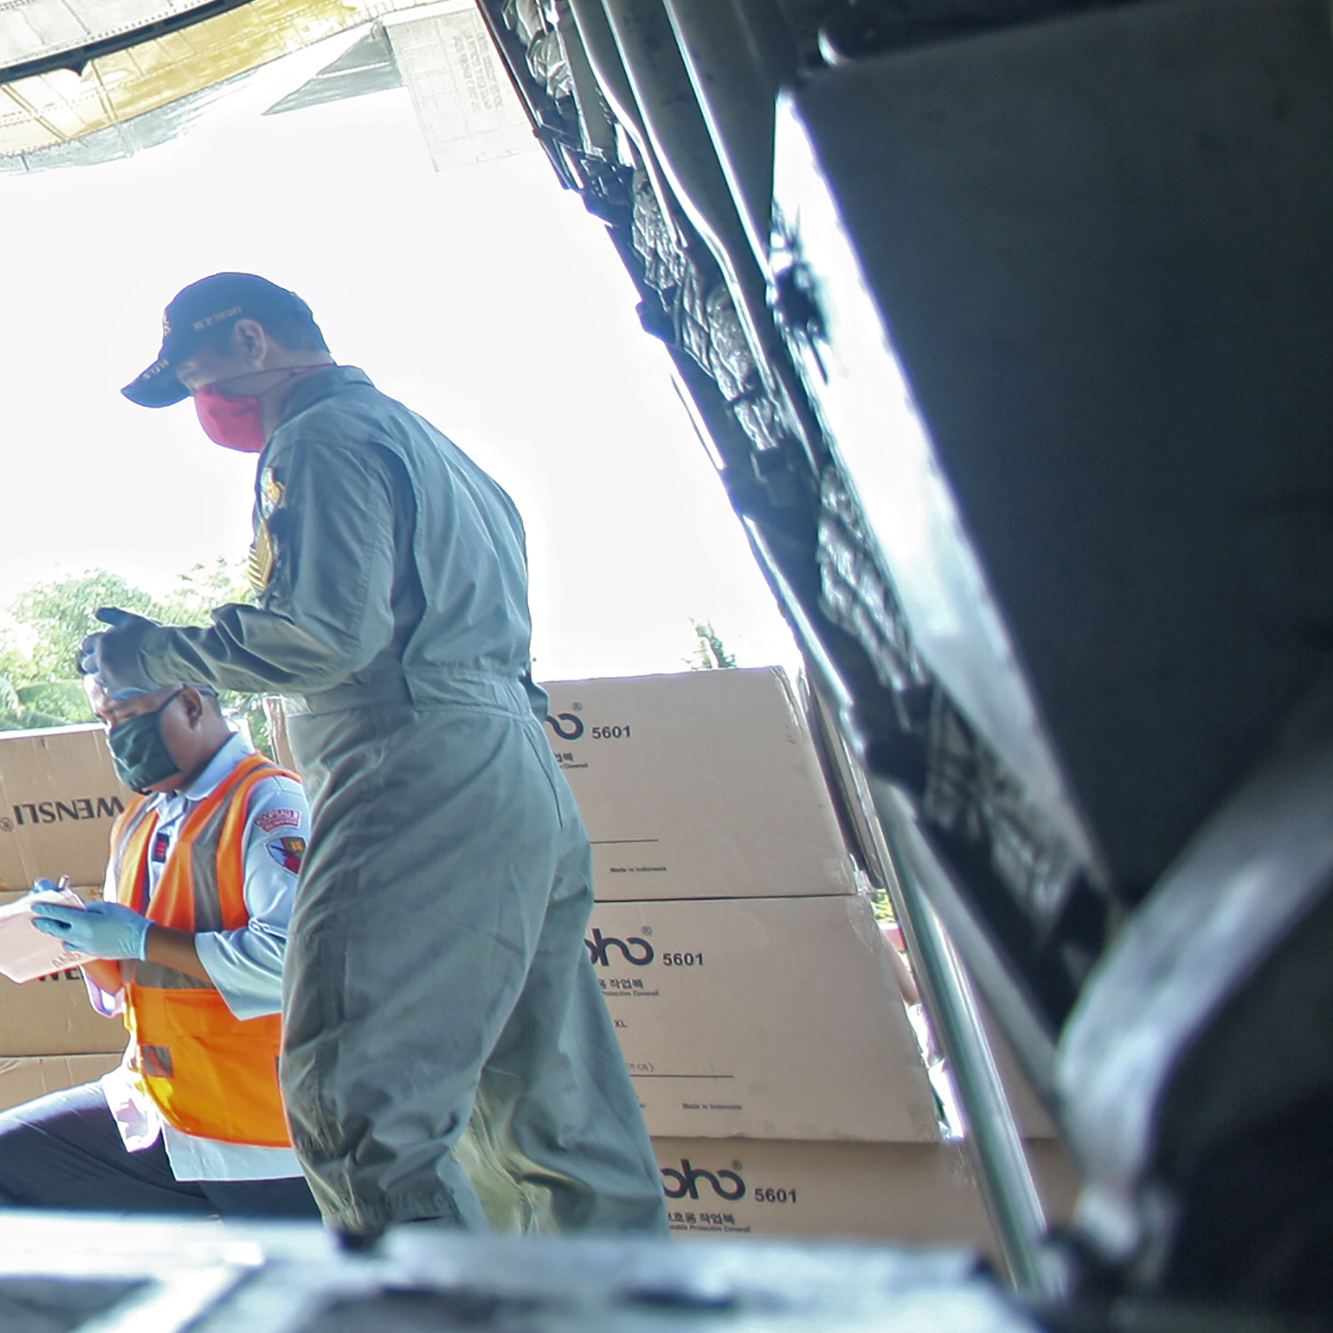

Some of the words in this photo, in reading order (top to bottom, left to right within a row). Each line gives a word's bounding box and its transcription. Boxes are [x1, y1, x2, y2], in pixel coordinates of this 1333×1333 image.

[591, 725, 631, 739] 5601
[12, 796, 125, 826] WENSLI
[662, 952, 705, 966] 5601
[754, 1187, 797, 1203] 5601
